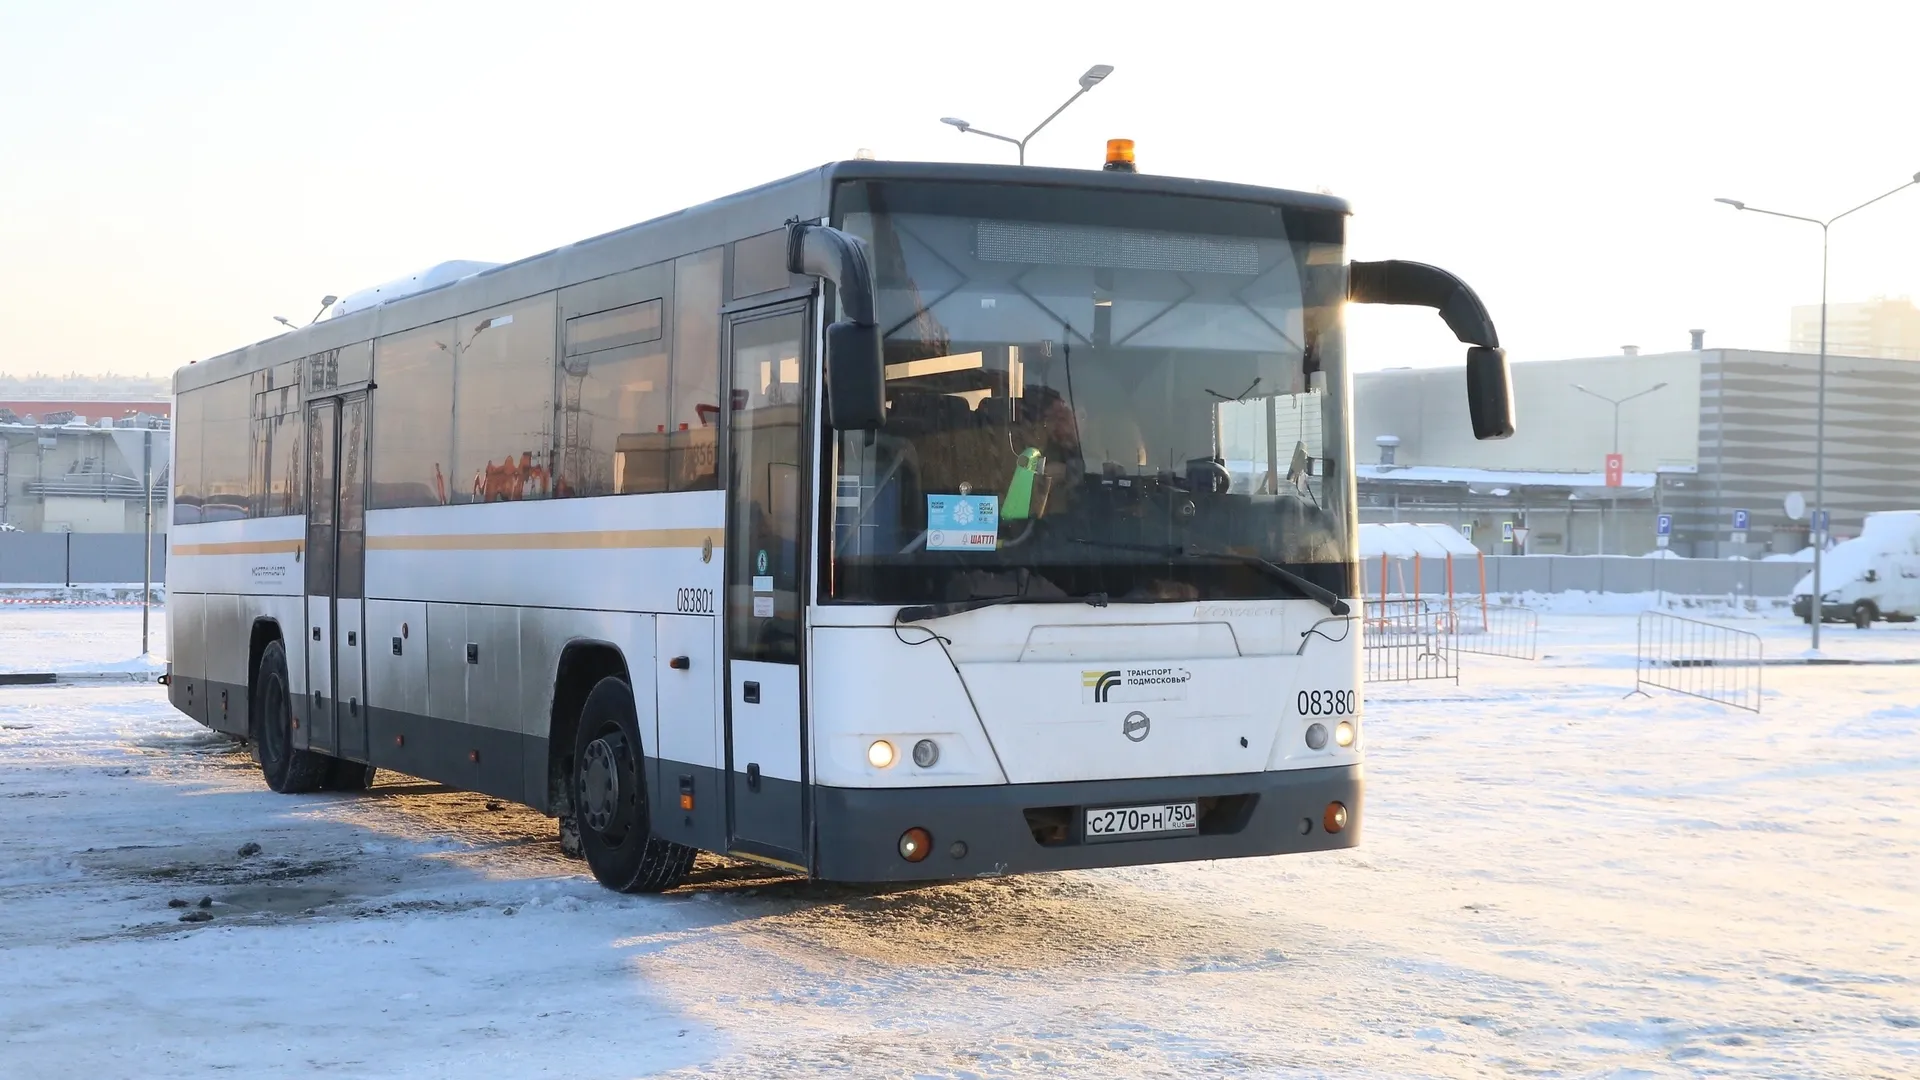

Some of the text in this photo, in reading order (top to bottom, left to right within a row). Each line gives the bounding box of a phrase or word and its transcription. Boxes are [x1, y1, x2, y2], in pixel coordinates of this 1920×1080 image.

[1659, 517, 1669, 533] P
[1736, 512, 1745, 527] P
[970, 535, 994, 544] ШАТТЛ
[676, 587, 714, 613] 083801
[1127, 668, 1172, 677] ТРАНСПОРТ
[1127, 677, 1186, 686] ПОДМОСКОВЬЯ
[1297, 689, 1357, 715] 08380
[1166, 805, 1192, 822] 750
